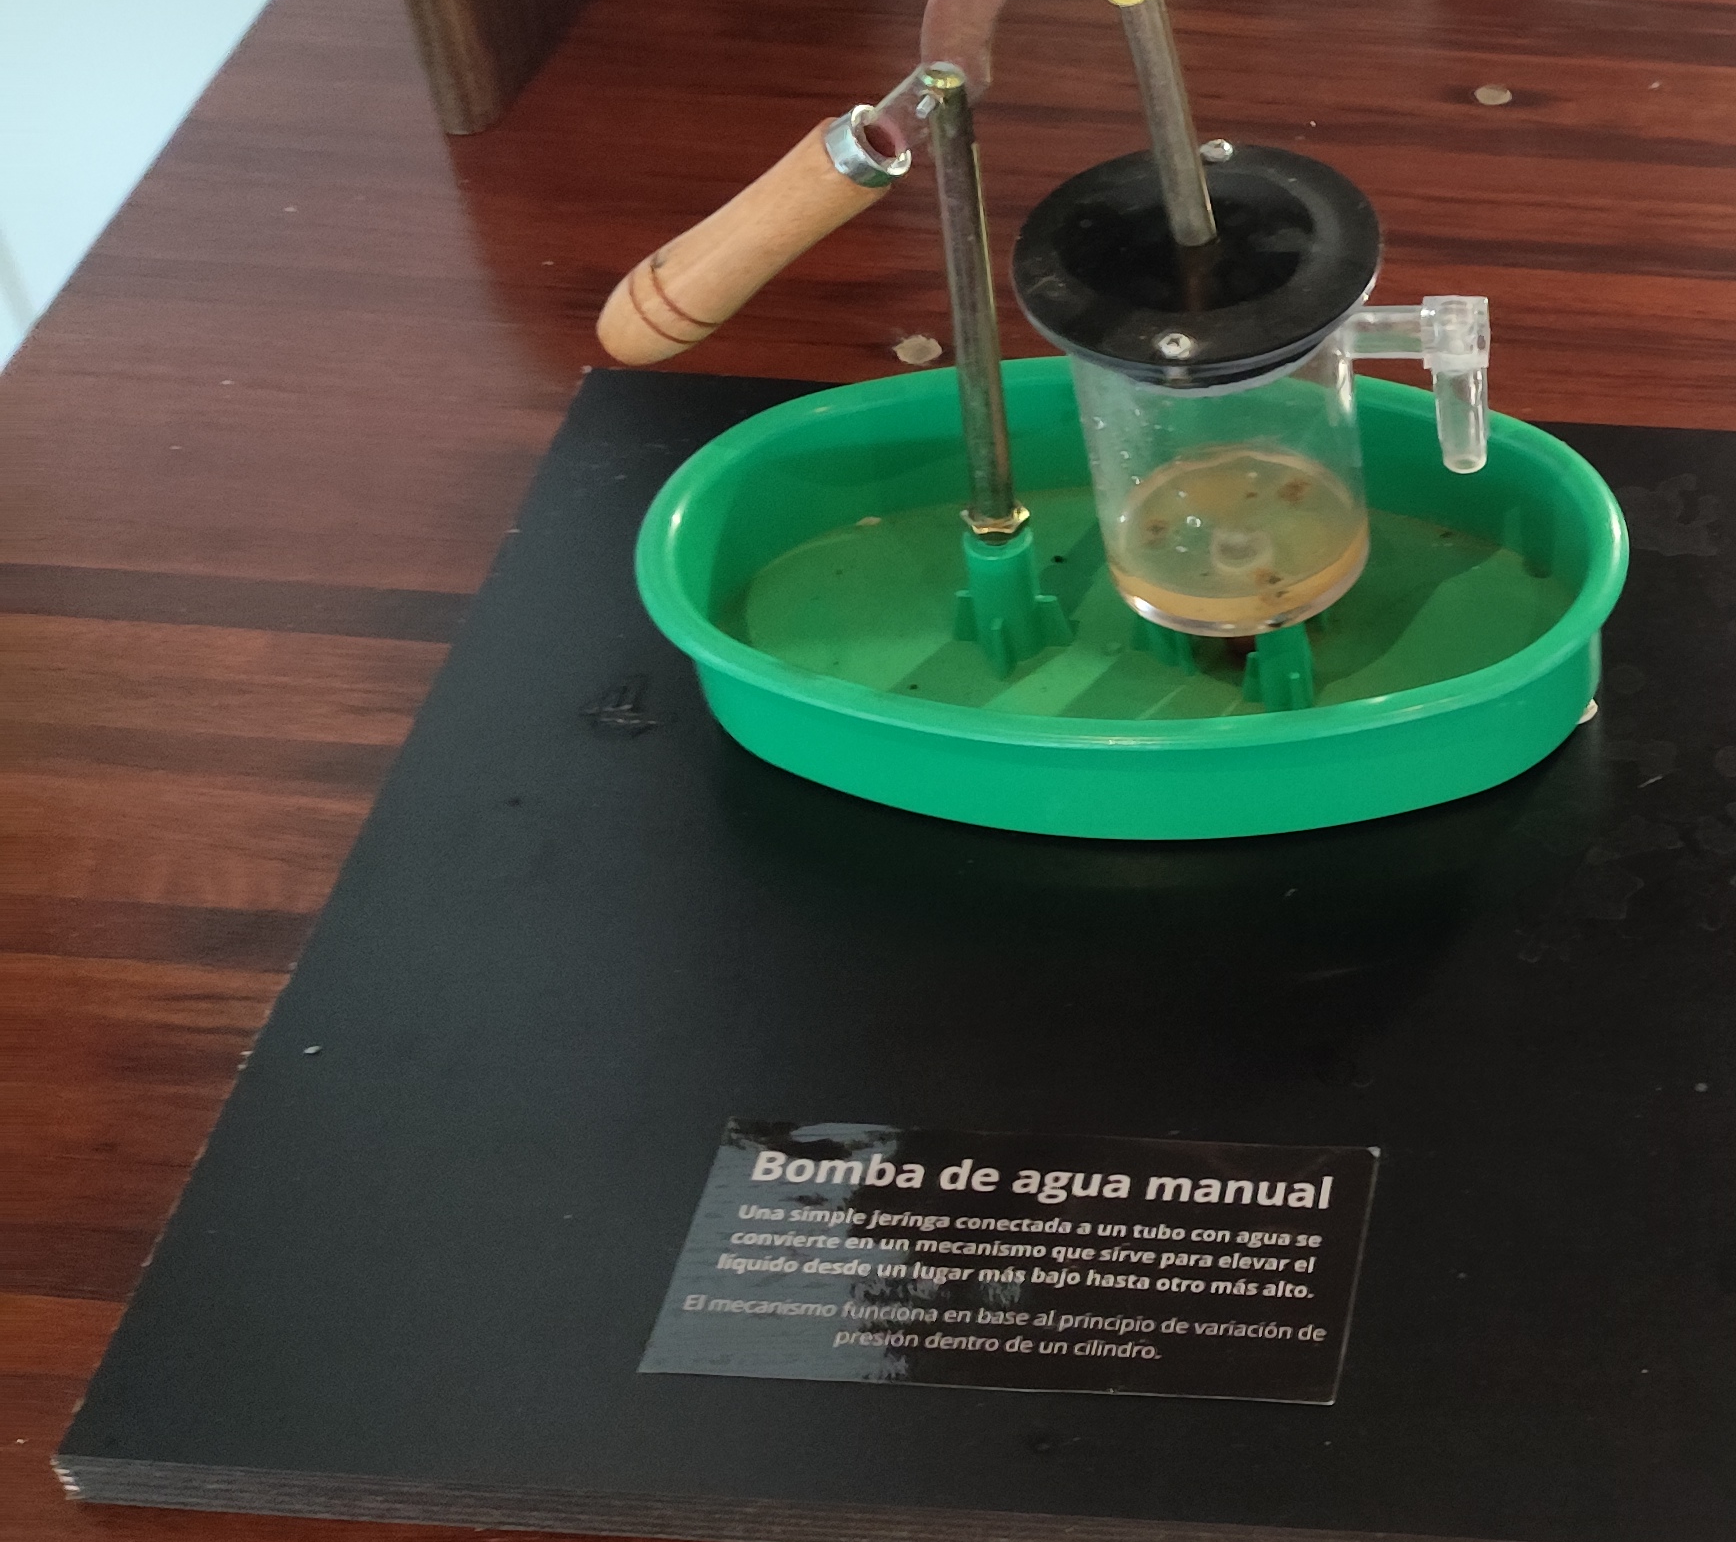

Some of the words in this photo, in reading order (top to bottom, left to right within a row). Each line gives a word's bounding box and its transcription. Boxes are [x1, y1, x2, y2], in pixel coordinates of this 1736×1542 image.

[751, 1150, 925, 1188] Bomba
[939, 1158, 1000, 1191] de
[1011, 1169, 1131, 1204] agua
[1145, 1176, 1334, 1209] manual
[738, 1204, 785, 1221] Una
[789, 1206, 866, 1227] simple
[866, 1210, 950, 1231] jeringa
[955, 1214, 1072, 1234] conectada
[1076, 1221, 1092, 1235] a
[1097, 1223, 1127, 1237] un
[1133, 1224, 1186, 1240] tubo
[1190, 1228, 1231, 1243] con
[1235, 1231, 1291, 1248] agua
[1295, 1234, 1323, 1248] se
[731, 1231, 840, 1248] convierte
[844, 1236, 874, 1249] en
[879, 1237, 910, 1251] un
[914, 1239, 1046, 1257] mecanismo
[1051, 1245, 1096, 1263] que
[1099, 1246, 1156, 1263] sirve
[1158, 1252, 1214, 1269] para
[1218, 1253, 1291, 1271] elevar
[1293, 1256, 1317, 1273] el
[716, 1253, 799, 1274] líquido
[802, 1258, 871, 1277] desde
[876, 1264, 907, 1279] un
[912, 1261, 975, 1285] lugar
[978, 1266, 1026, 1284] más
[1031, 1267, 1081, 1289] bajo
[1086, 1269, 1150, 1290] hasta
[1156, 1277, 1206, 1293] otro
[1209, 1278, 1260, 1296] más
[1262, 1280, 1315, 1299] alto.
[683, 1294, 708, 1311] El
[709, 1298, 837, 1317] mecanismo
[840, 1301, 937, 1323] funciona
[944, 1309, 971, 1324] en
[977, 1307, 1029, 1326] base
[1033, 1310, 1056, 1327] al
[1058, 1312, 1156, 1335] principio
[1161, 1317, 1190, 1334] de
[1194, 1320, 1293, 1340] variación
[1298, 1324, 1327, 1342] de
[832, 1330, 919, 1348] presión
[924, 1332, 999, 1352] dentro
[1004, 1335, 1034, 1354] de
[1038, 1340, 1068, 1355] un
[1073, 1340, 1162, 1359] cilindro.
